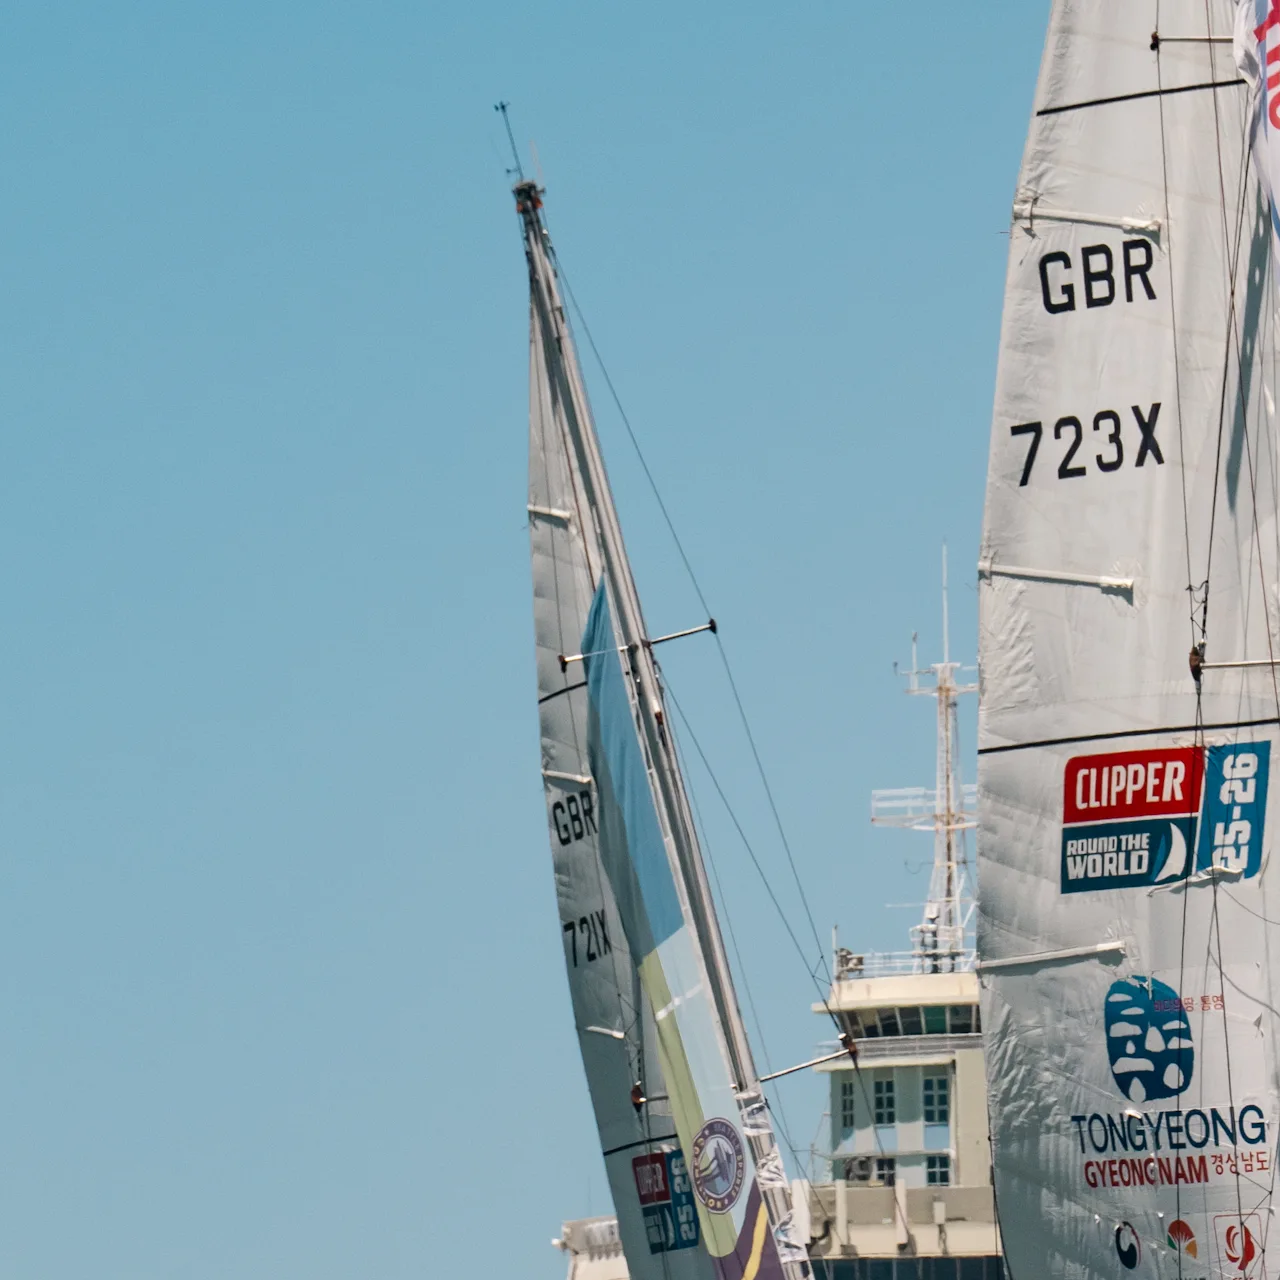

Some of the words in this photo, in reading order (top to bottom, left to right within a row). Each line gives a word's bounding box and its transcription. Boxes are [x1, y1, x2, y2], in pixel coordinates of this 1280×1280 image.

[1039, 238, 1157, 315] GBR
[1010, 402, 1165, 488] 723X
[1075, 760, 1186, 810] CLIPPER
[1212, 752, 1259, 873] 25-26
[552, 790, 598, 847] GBR
[1067, 836, 1118, 856] ROUND
[1119, 833, 1151, 852] THE
[1067, 850, 1150, 881] WORLD
[563, 909, 613, 968] 721X
[1071, 1104, 1267, 1154] TONGYEONG
[1211, 1150, 1269, 1175] 경상남도
[671, 1156, 697, 1241] 25-26
